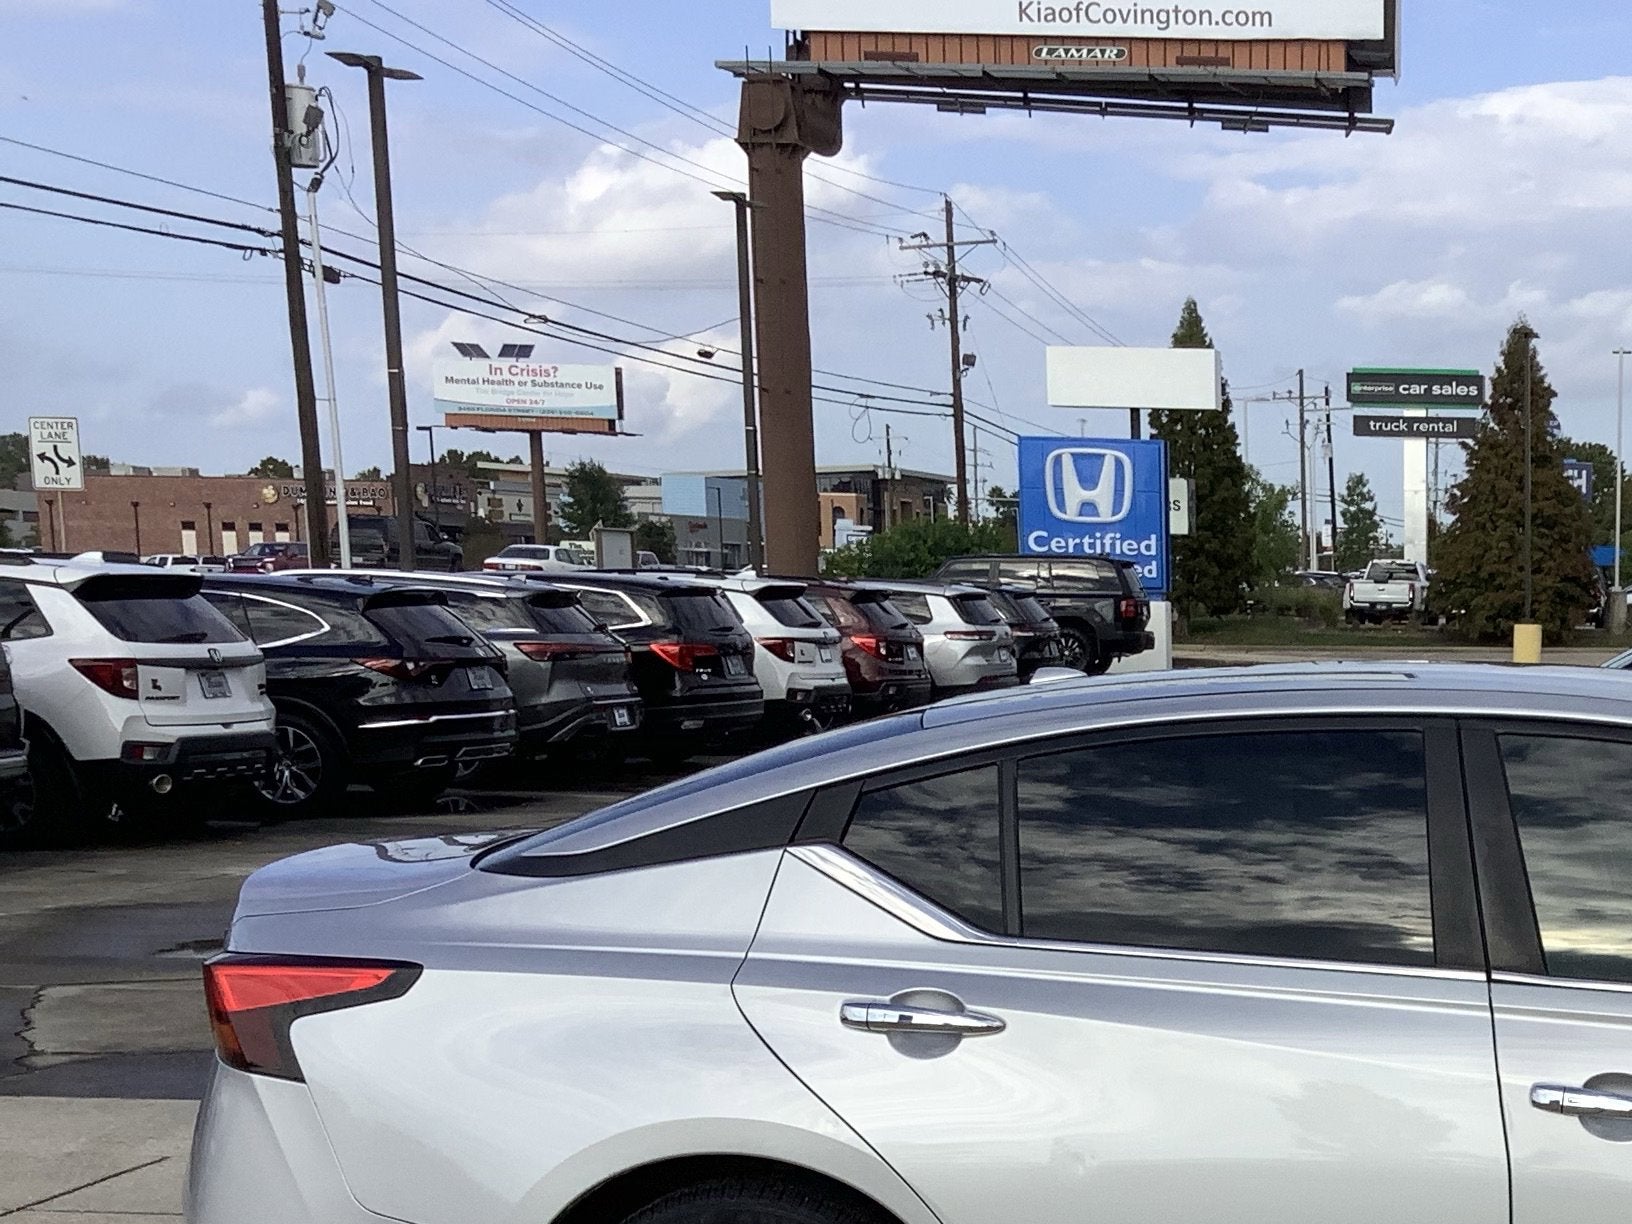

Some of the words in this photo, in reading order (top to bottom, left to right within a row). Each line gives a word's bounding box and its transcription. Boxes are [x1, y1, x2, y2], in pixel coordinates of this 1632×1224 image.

[1018, 1, 1273, 31] KiaofCovington.com
[1041, 47, 1119, 59] LAMAR
[489, 363, 503, 376] In
[508, 364, 558, 378] Crisis?
[445, 376, 480, 385] Mental
[482, 377, 515, 387] Health
[530, 380, 583, 390] Substance
[585, 381, 604, 390] Use
[1399, 383, 1429, 395] car
[1431, 381, 1479, 396] sales
[33, 421, 74, 431] CENTER
[1369, 419, 1408, 431] truck
[1413, 420, 1457, 433] rental
[41, 431, 68, 440] LANE
[44, 475, 71, 486] ONLY
[1027, 530, 1157, 556] Certified
